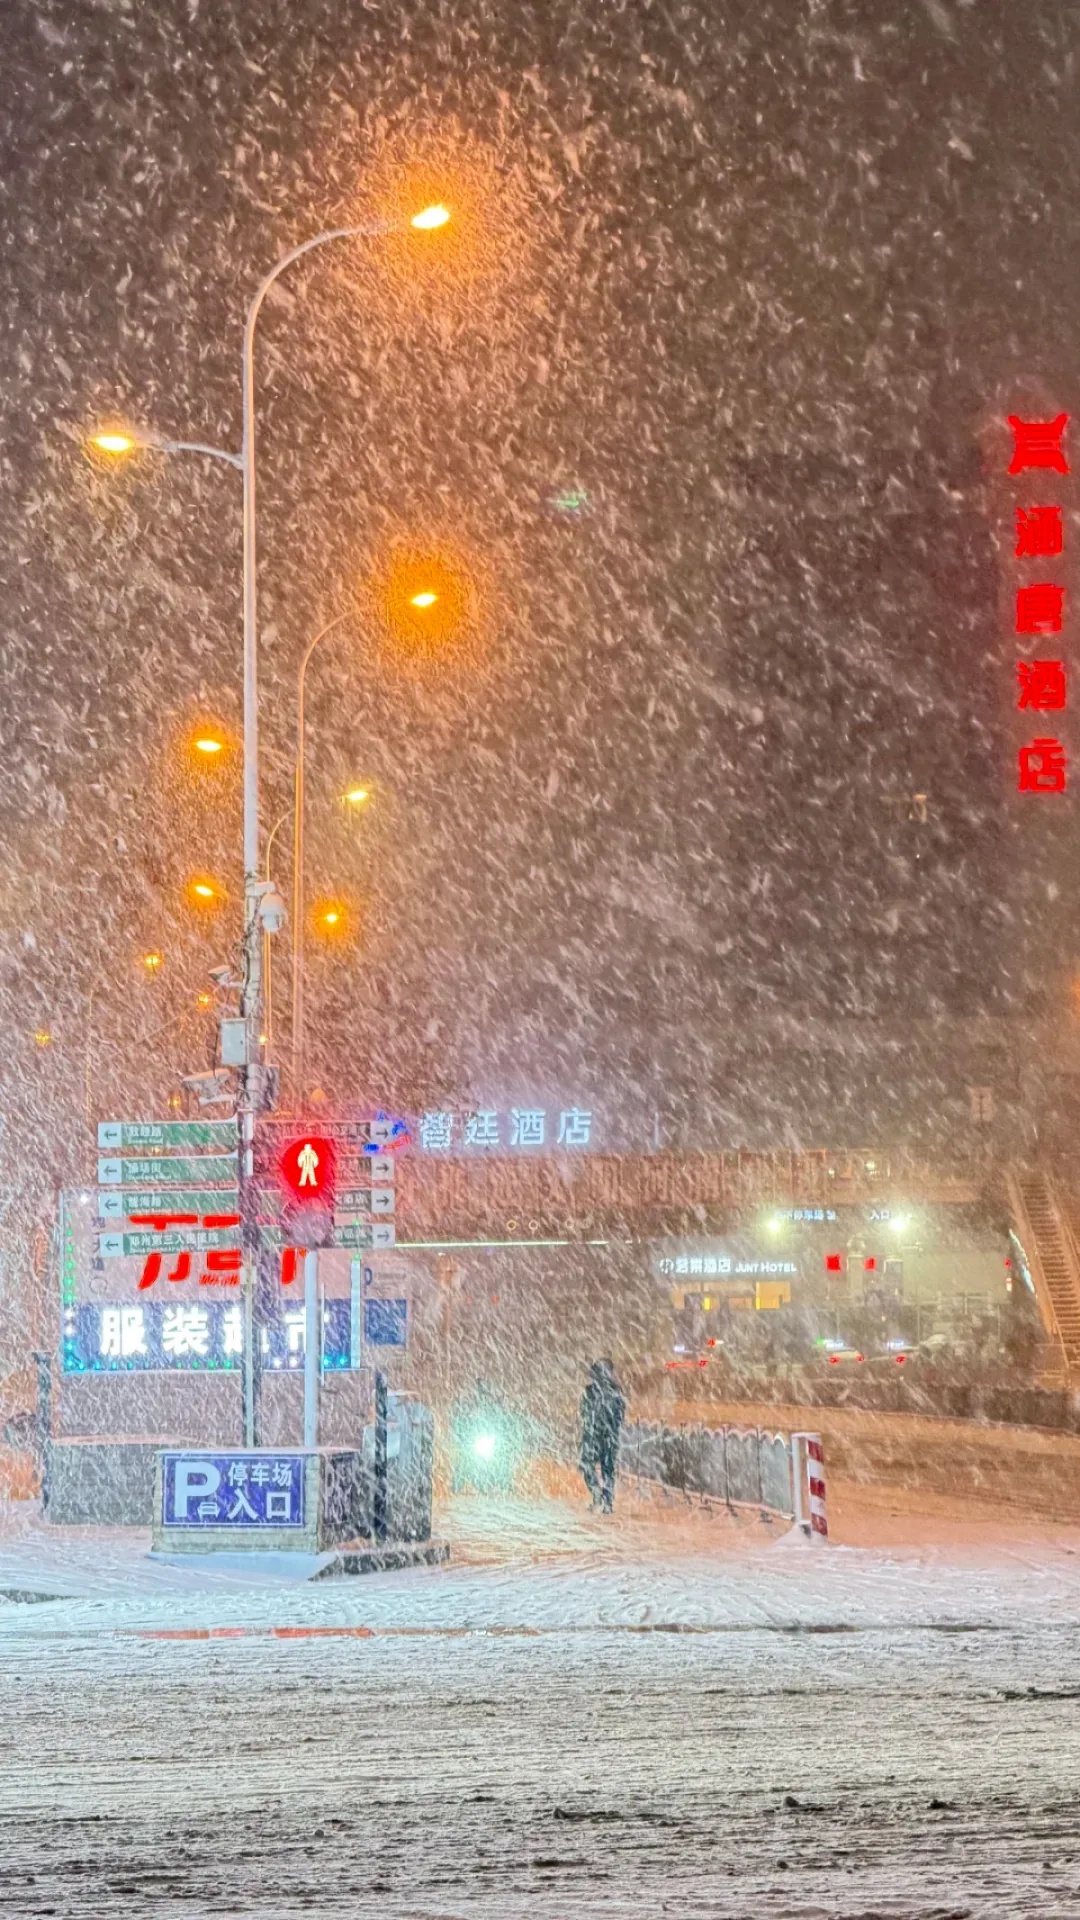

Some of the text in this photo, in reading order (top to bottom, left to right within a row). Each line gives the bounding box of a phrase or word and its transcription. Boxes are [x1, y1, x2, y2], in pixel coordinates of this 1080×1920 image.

[760, 1261, 798, 1273] HOTEL
[174, 1461, 292, 1518] P 停车场
[226, 1488, 291, 1520] 入口
